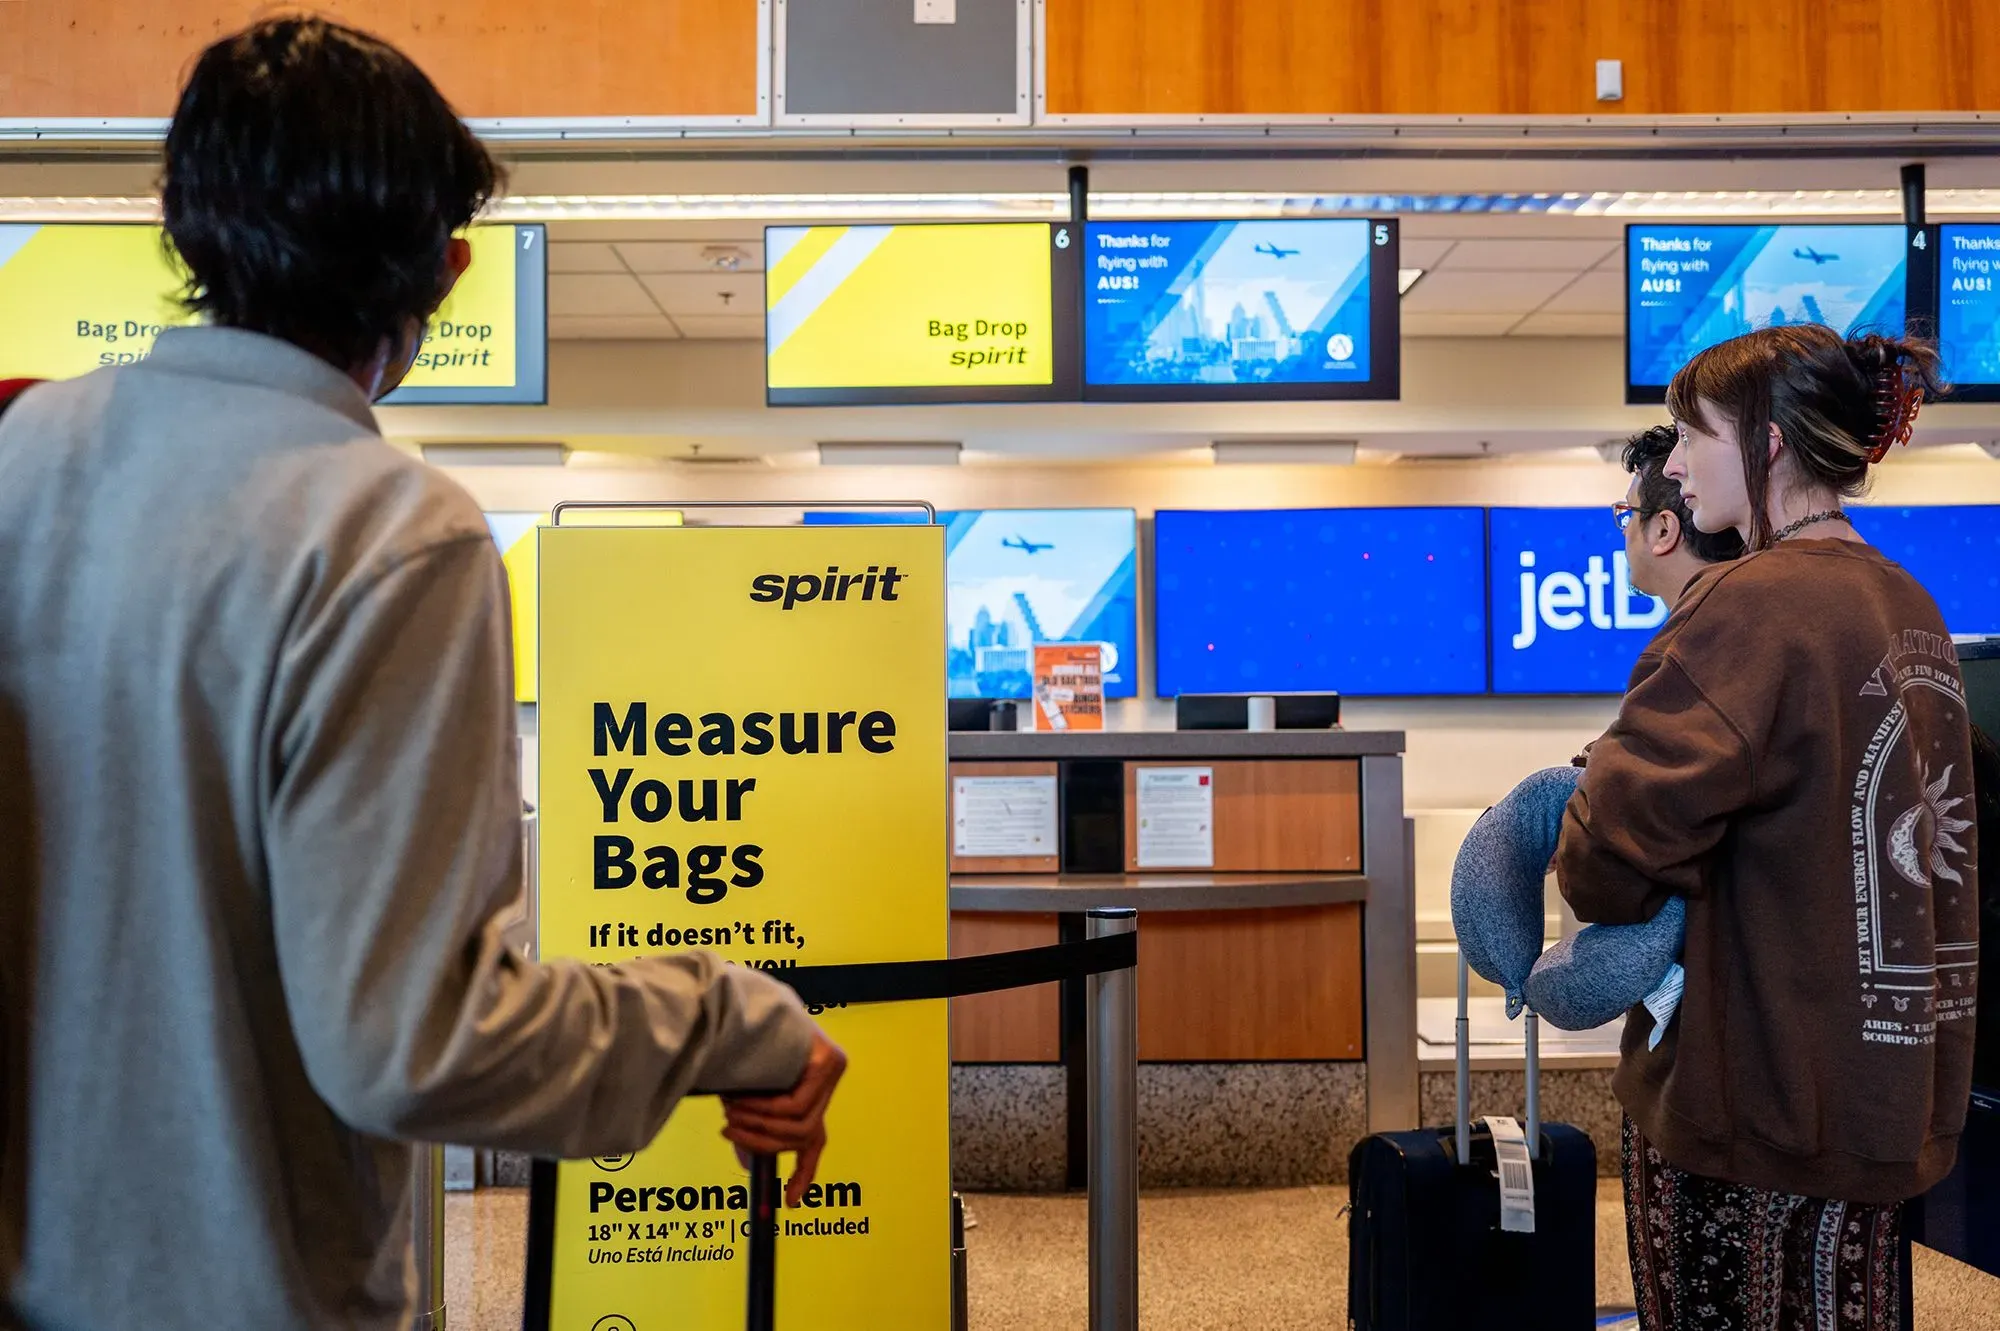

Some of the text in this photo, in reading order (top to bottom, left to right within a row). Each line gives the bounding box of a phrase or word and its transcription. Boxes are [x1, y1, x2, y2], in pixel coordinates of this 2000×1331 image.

[521, 230, 535, 250] 7
[1055, 228, 1070, 249] 6
[1097, 233, 1171, 248] Thanks for
[1374, 224, 1389, 246] 5
[1641, 236, 1712, 252] Thanks for
[1912, 230, 1927, 250] 4
[1097, 254, 1168, 272] flying with
[1641, 257, 1710, 275] flying with
[1952, 256, 1989, 274] flying
[1097, 275, 1139, 290] AUS!
[1641, 278, 1682, 293] AUS!
[1951, 277, 1992, 292] AUS!
[77, 320, 161, 343] Bag Dro
[440, 321, 492, 342] Drop
[928, 320, 1027, 342] Bag Drop
[415, 349, 493, 371] spirit
[950, 346, 1029, 369] spirit
[593, 702, 896, 757] Measure
[587, 768, 756, 823] Your
[1853, 769, 1870, 801] AND
[1851, 804, 1865, 846] FLOW
[593, 835, 764, 904] Bags
[1853, 849, 1869, 904] ENERGY
[589, 924, 611, 948] If
[618, 922, 639, 947] it
[763, 919, 805, 949] fit,
[1856, 906, 1870, 944] YOUR
[1858, 946, 1872, 975] LET
[1863, 1019, 1902, 1032] ARIES
[1862, 1031, 1918, 1046] SCORPIO
[589, 1181, 748, 1213] Persona
[628, 1223, 641, 1240] X
[685, 1221, 698, 1239] X
[740, 1219, 780, 1237] Oe
[785, 1216, 870, 1236] Included
[588, 1244, 734, 1264] Uno Está Incluido
